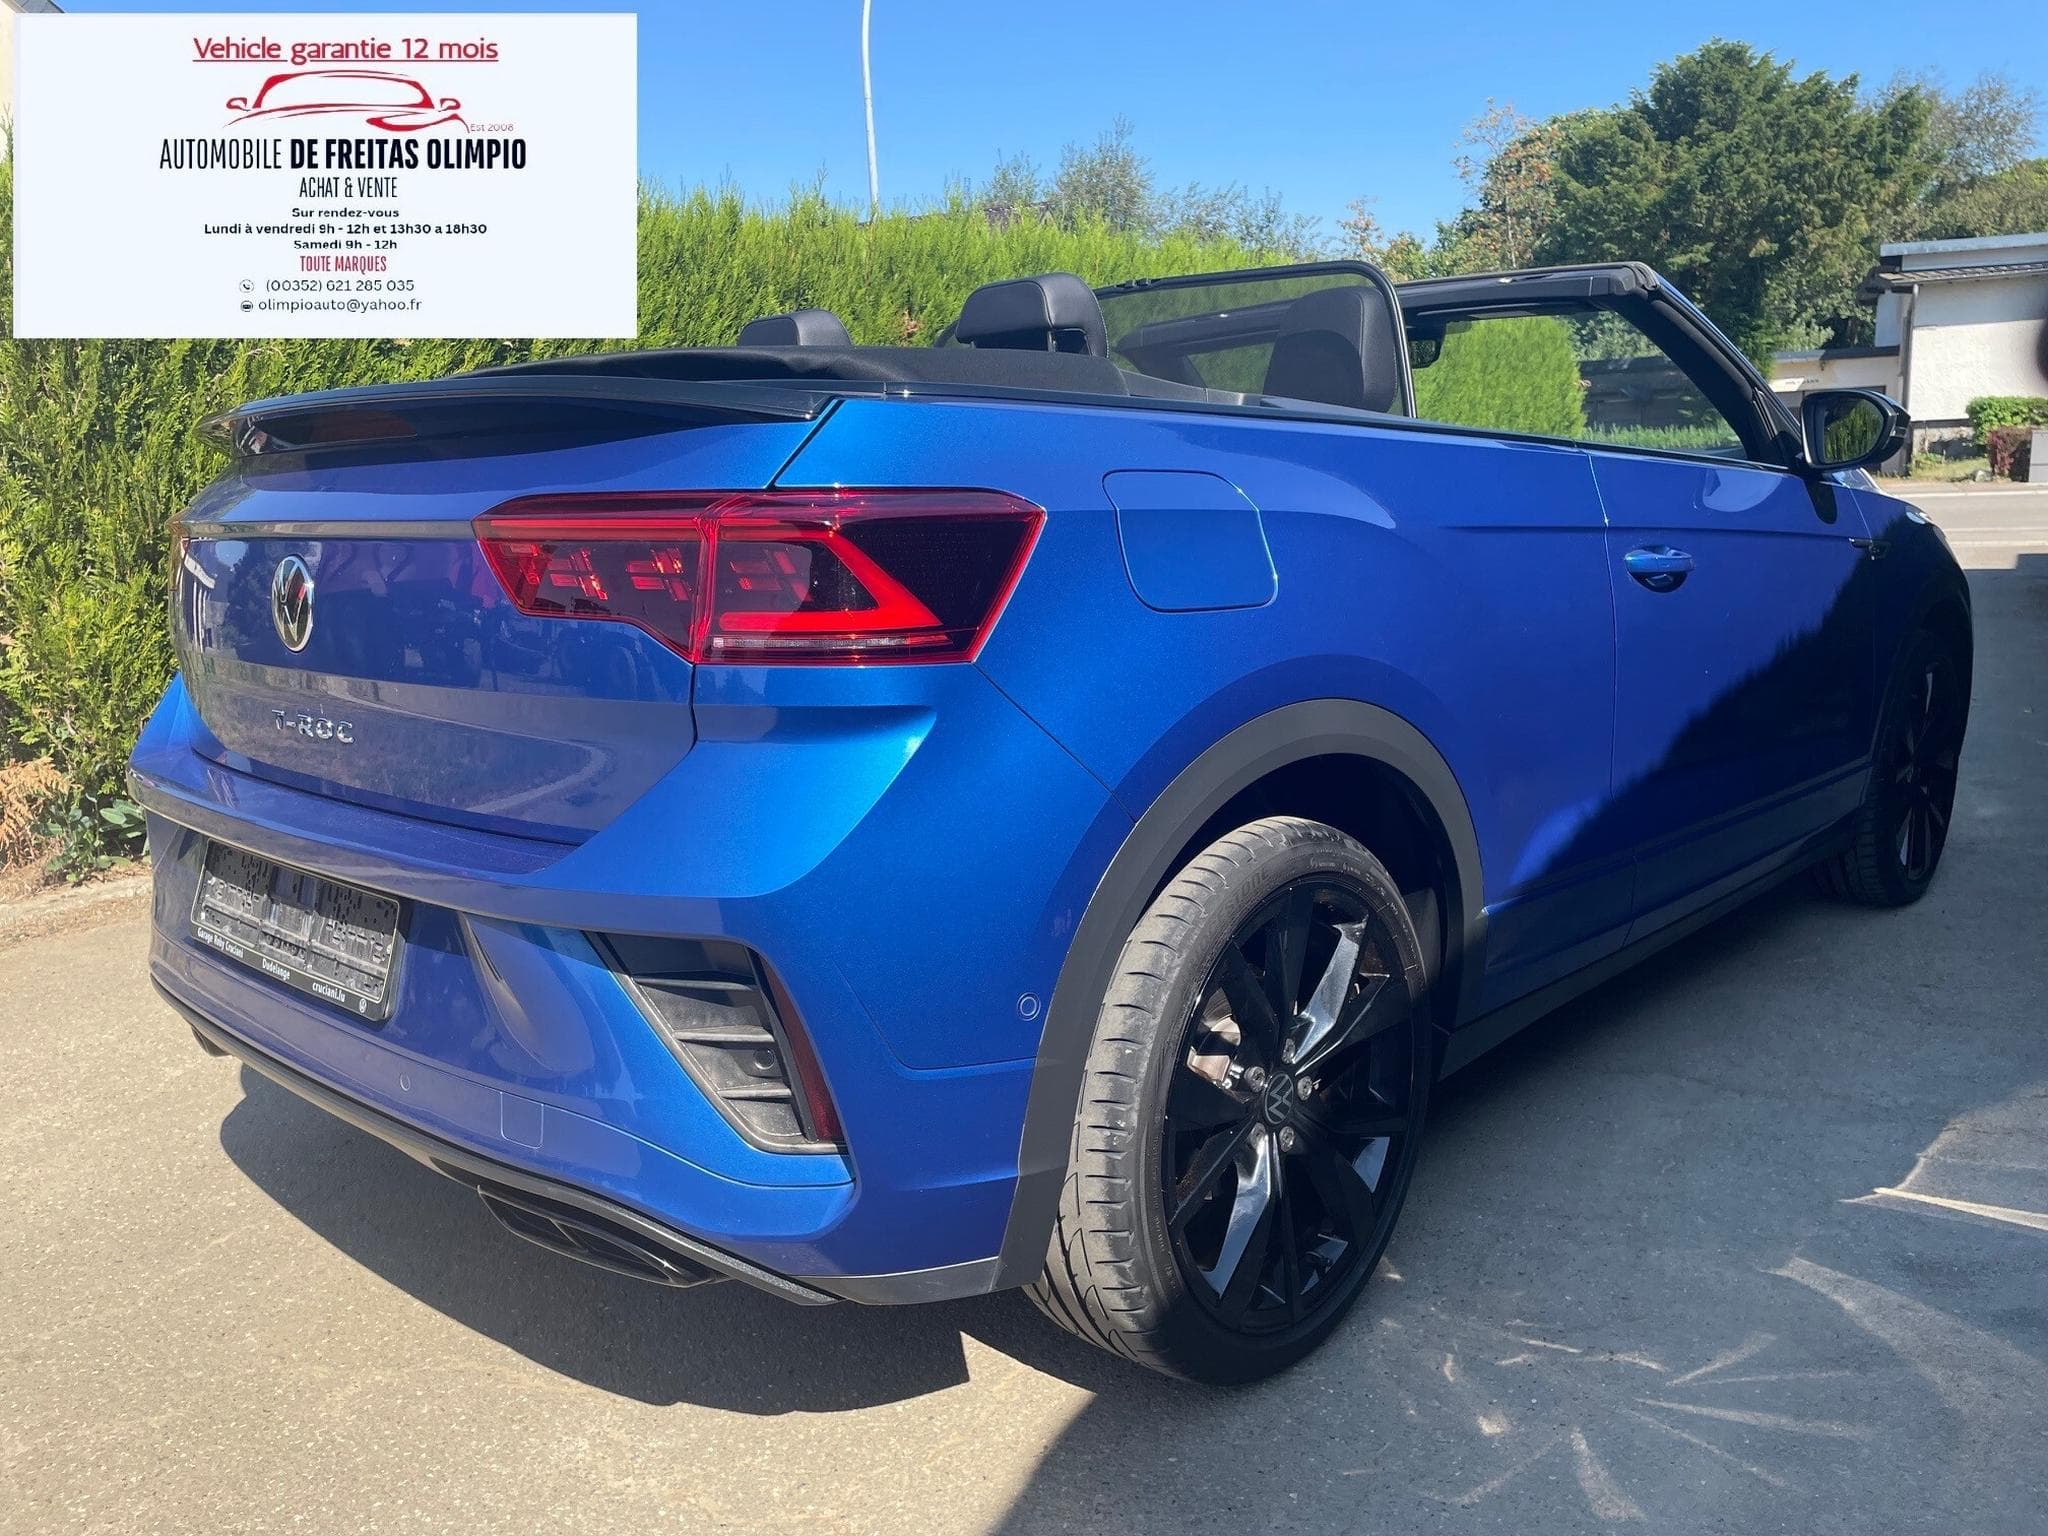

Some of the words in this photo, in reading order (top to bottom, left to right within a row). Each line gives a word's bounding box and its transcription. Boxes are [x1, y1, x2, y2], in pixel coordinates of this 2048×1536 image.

[271, 708, 355, 745] T-ROC
[262, 958, 290, 981] Dudelange
[312, 981, 346, 1003] cruciani.lu
